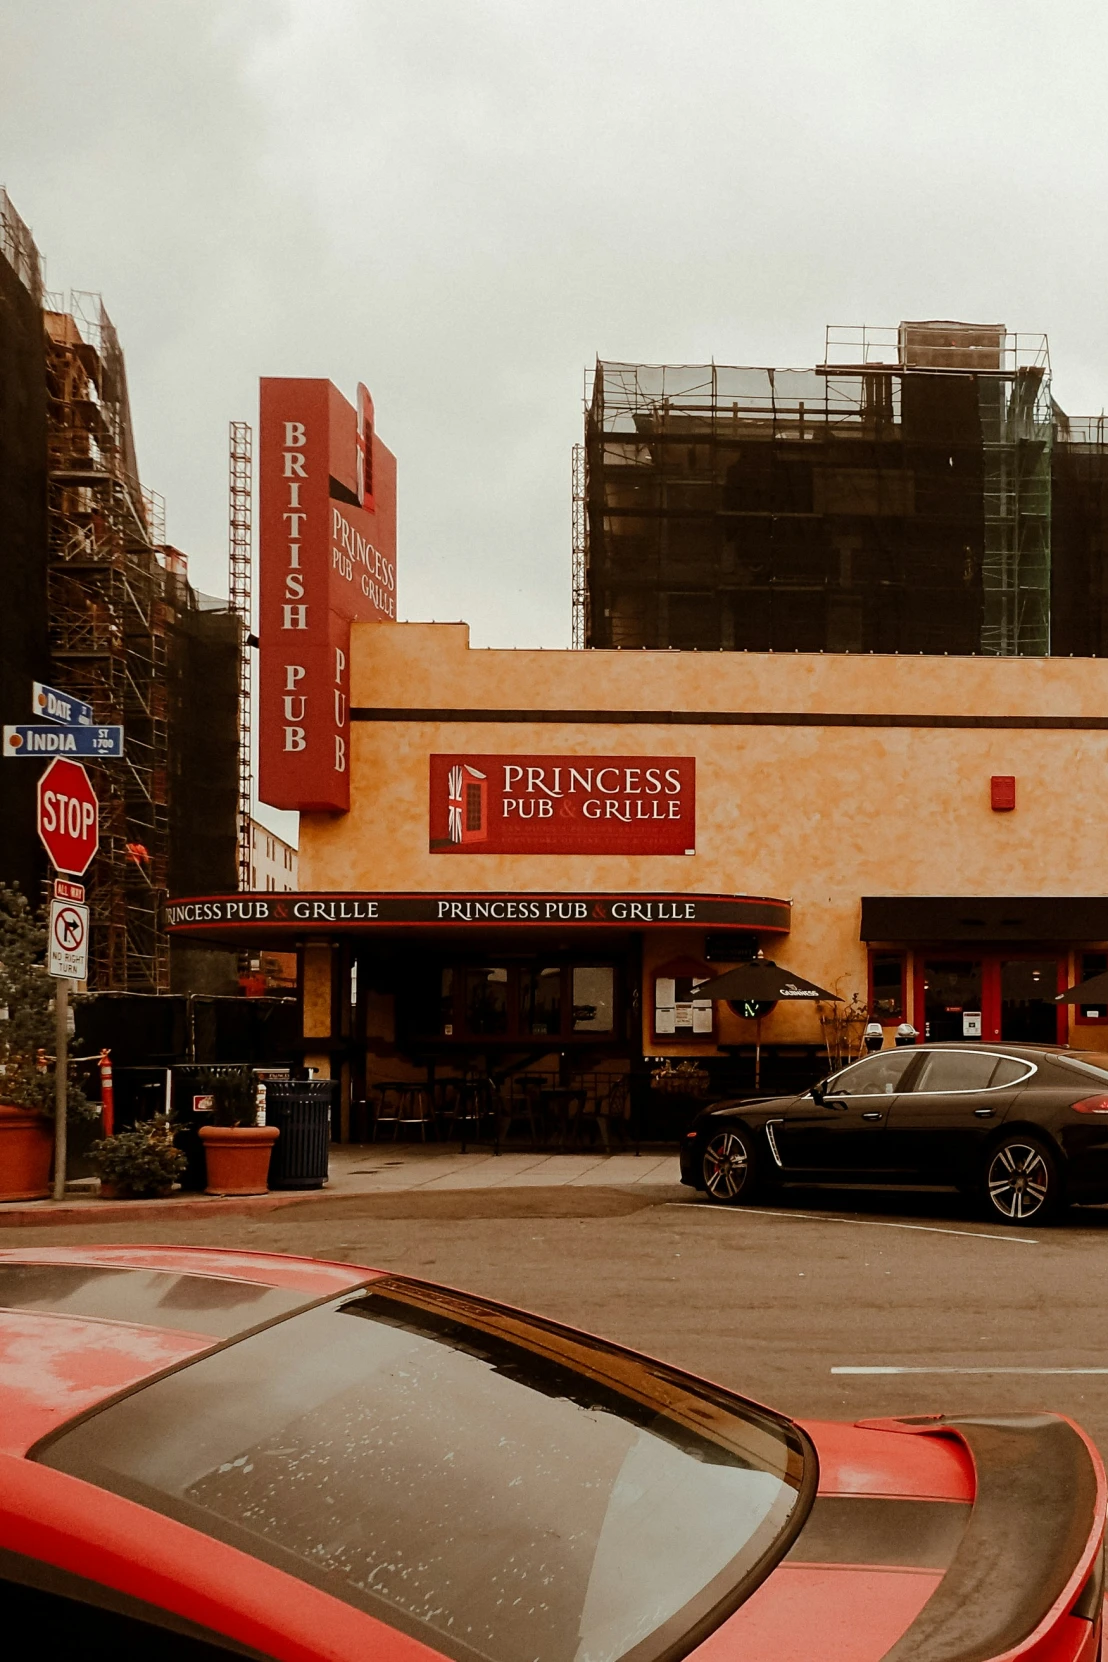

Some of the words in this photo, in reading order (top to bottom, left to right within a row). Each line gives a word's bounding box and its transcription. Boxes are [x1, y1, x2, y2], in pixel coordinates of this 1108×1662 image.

[282, 421, 309, 630] BRITISH
[332, 507, 394, 592] PRINCESS
[332, 547, 354, 582] PUB
[361, 574, 395, 619] GRILLE
[47, 693, 72, 721] DATE
[282, 665, 308, 752] PUB
[334, 647, 347, 773] PUB
[26, 730, 77, 751] INDIA
[98, 729, 109, 738] ST
[503, 765, 682, 798] PRINCESS
[43, 790, 95, 840] STOP
[503, 799, 554, 819] PUB
[559, 800, 577, 818] &
[582, 800, 682, 822] GRILLE
[226, 902, 269, 919] PUB
[273, 903, 289, 919] &
[294, 902, 379, 921] GRILLE
[437, 901, 540, 921] PRINCESS
[545, 902, 588, 919] PUB
[592, 903, 607, 919] &
[611, 902, 696, 921] GRILLE
[52, 951, 62, 961] NO
[64, 953, 84, 964] RIGHT
[58, 962, 78, 975] TURN
